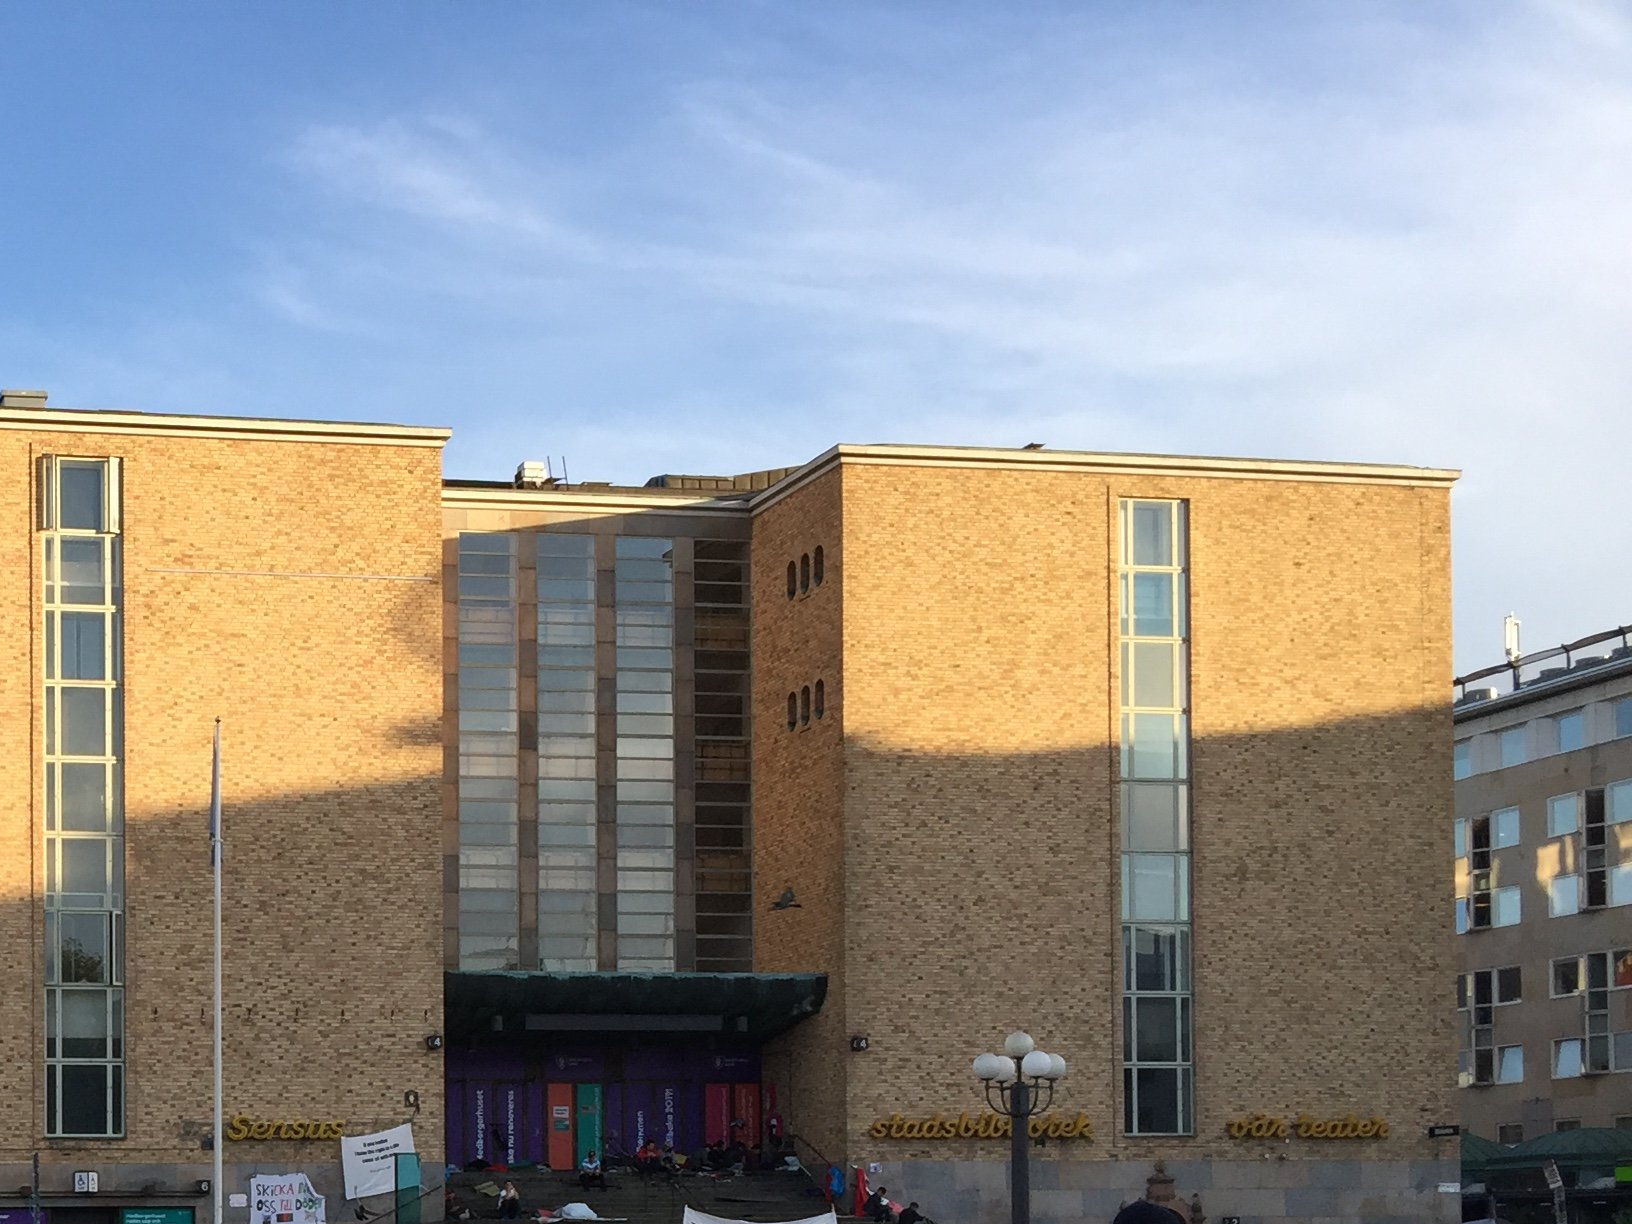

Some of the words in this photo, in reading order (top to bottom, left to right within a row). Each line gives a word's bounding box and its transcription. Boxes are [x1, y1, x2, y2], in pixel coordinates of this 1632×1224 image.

[226, 1115, 345, 1141] Sensus
[871, 1112, 1094, 1140] stadsbibotek
[1296, 1113, 1389, 1139] teater
[201, 1182, 208, 1191] 6
[256, 1199, 277, 1214] OSS
